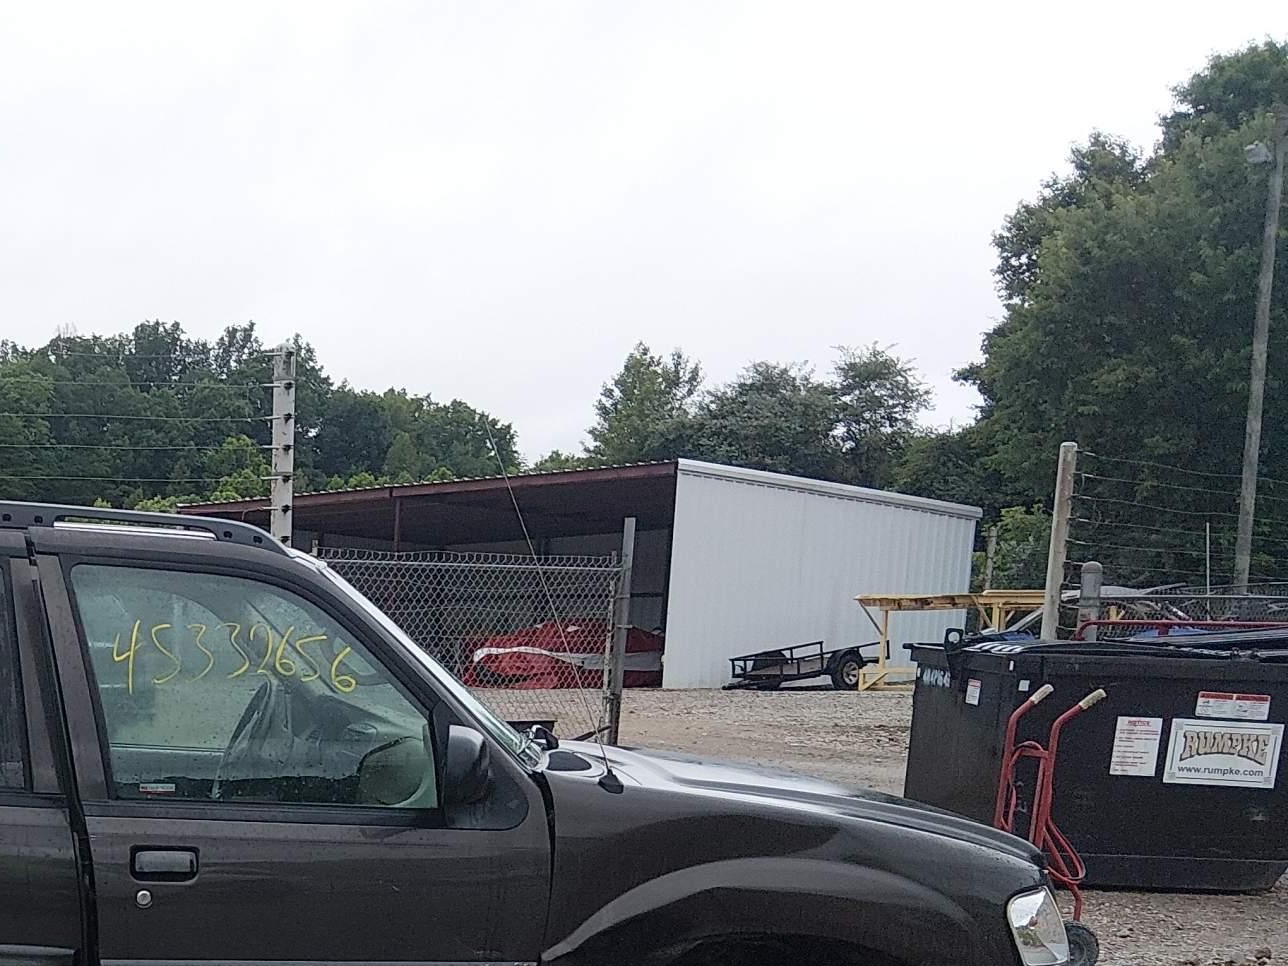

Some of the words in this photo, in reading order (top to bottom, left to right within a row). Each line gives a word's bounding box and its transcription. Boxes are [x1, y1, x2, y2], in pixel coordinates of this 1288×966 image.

[113, 619, 357, 695] 45332656
[1179, 730, 1271, 767] RUMPKE
[1177, 765, 1264, 778] www.rumpke.com
